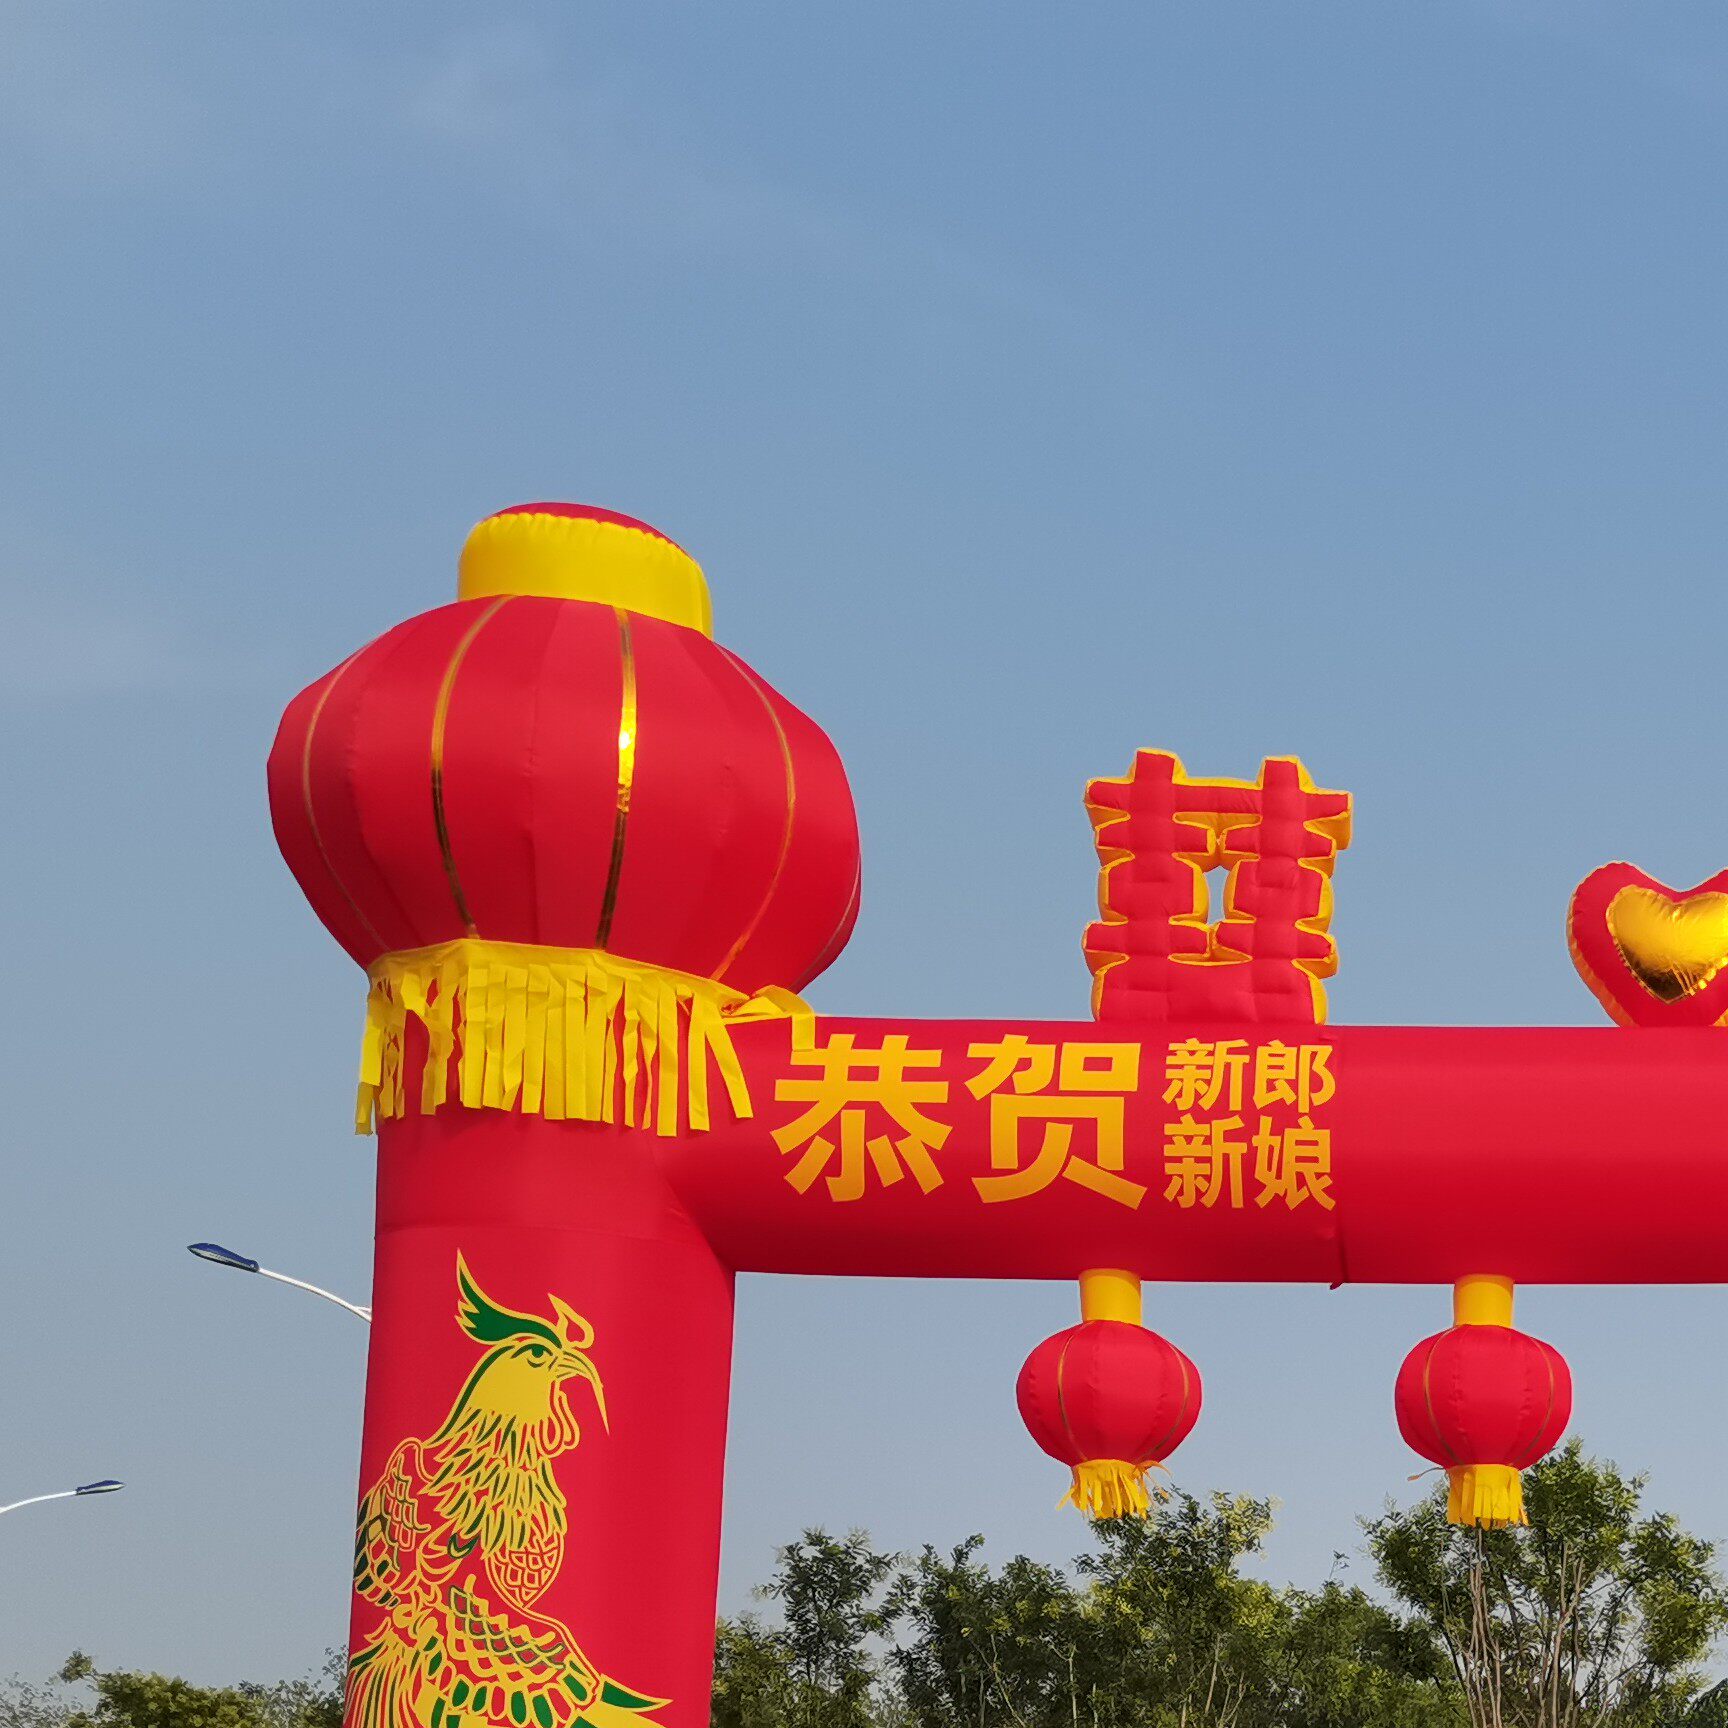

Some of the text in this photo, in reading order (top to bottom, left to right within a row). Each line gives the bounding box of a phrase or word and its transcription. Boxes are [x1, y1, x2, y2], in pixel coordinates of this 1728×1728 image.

[770, 1033, 1148, 1211] 恭贺
[1162, 1038, 1337, 1113] 新郎
[1162, 1113, 1337, 1211] 新娘
